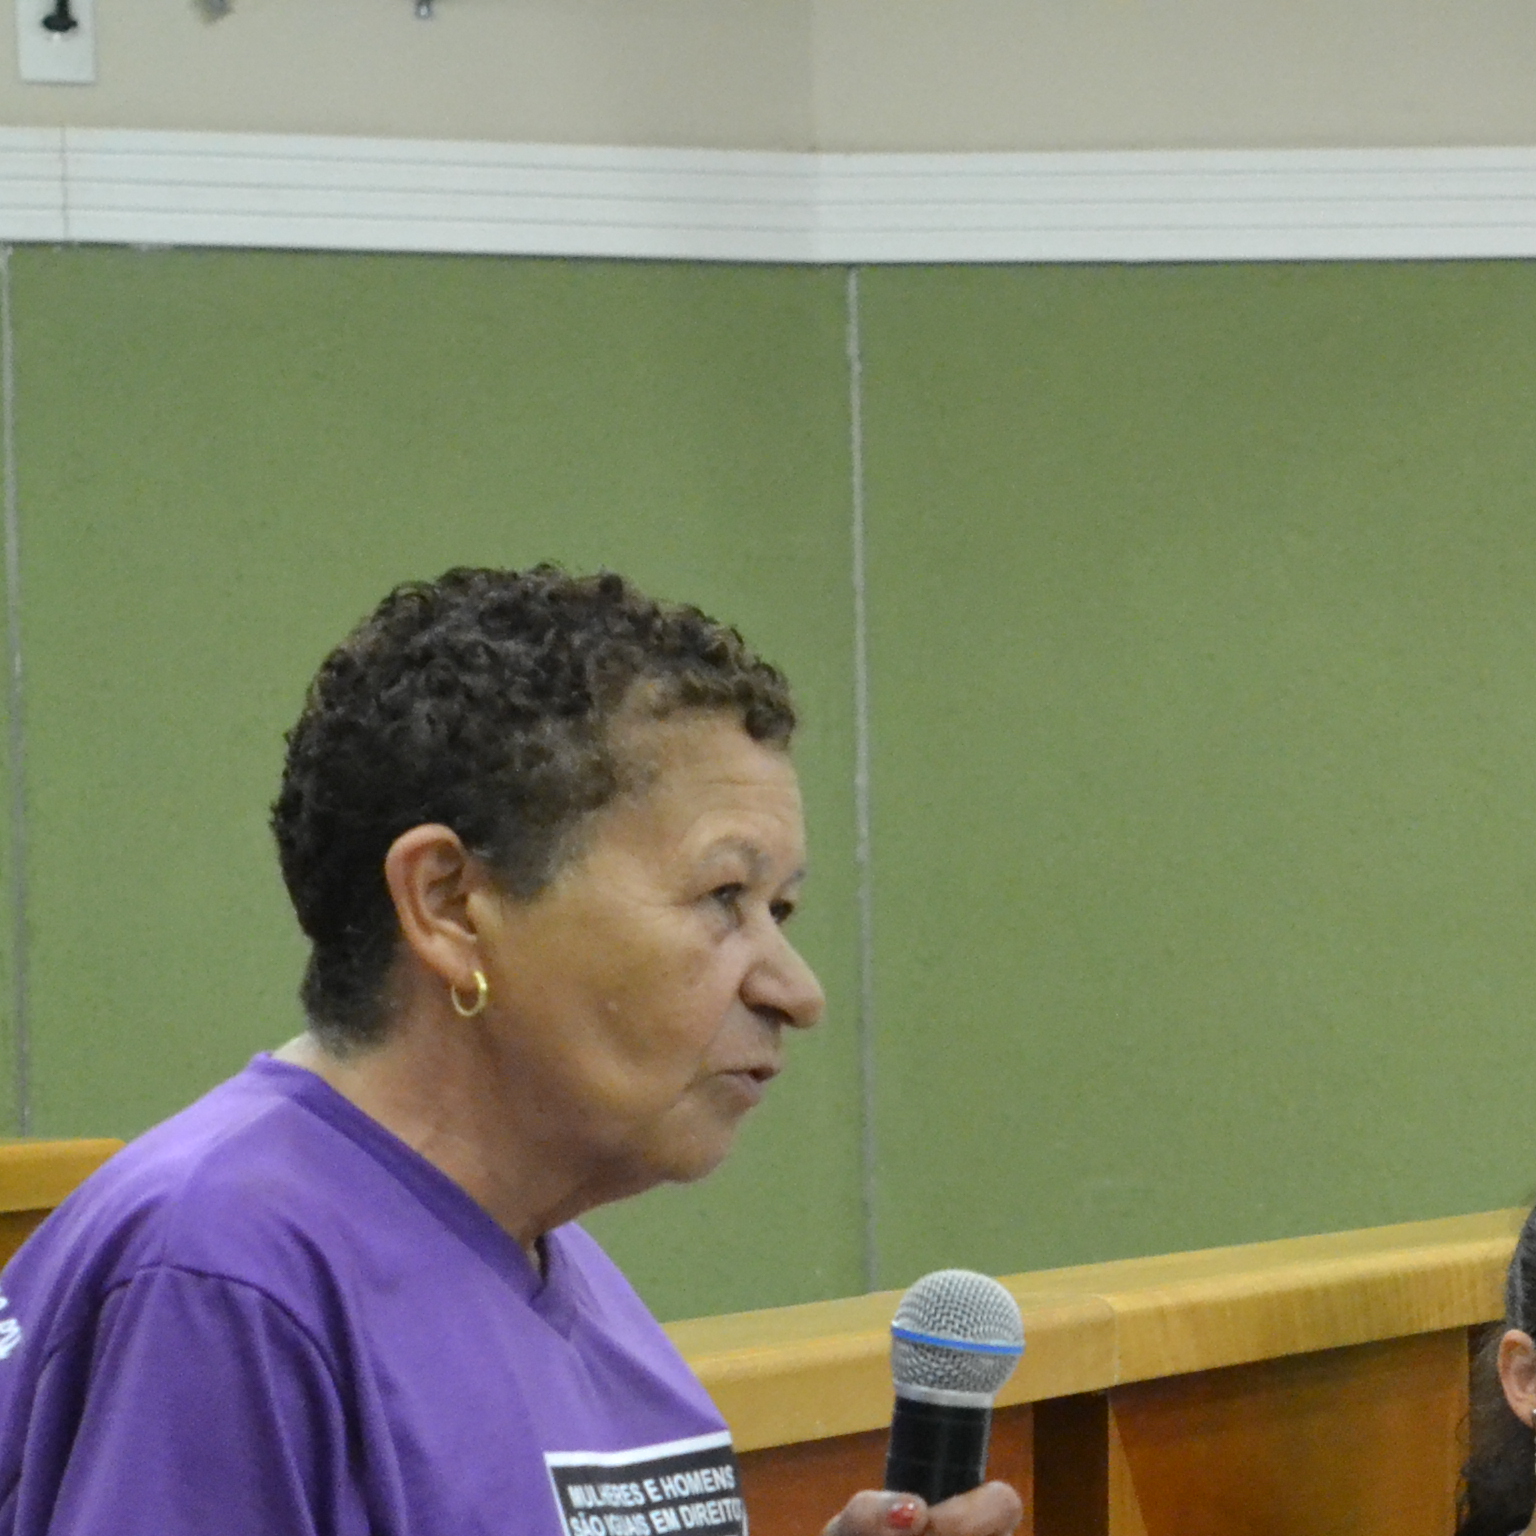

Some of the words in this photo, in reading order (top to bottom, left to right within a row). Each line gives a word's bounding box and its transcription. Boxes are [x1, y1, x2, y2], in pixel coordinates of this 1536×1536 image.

[643, 1479, 663, 1503] E
[659, 1464, 736, 1499] HOMENS
[650, 1508, 681, 1534] EM
[679, 1497, 744, 1529] DIREITO
